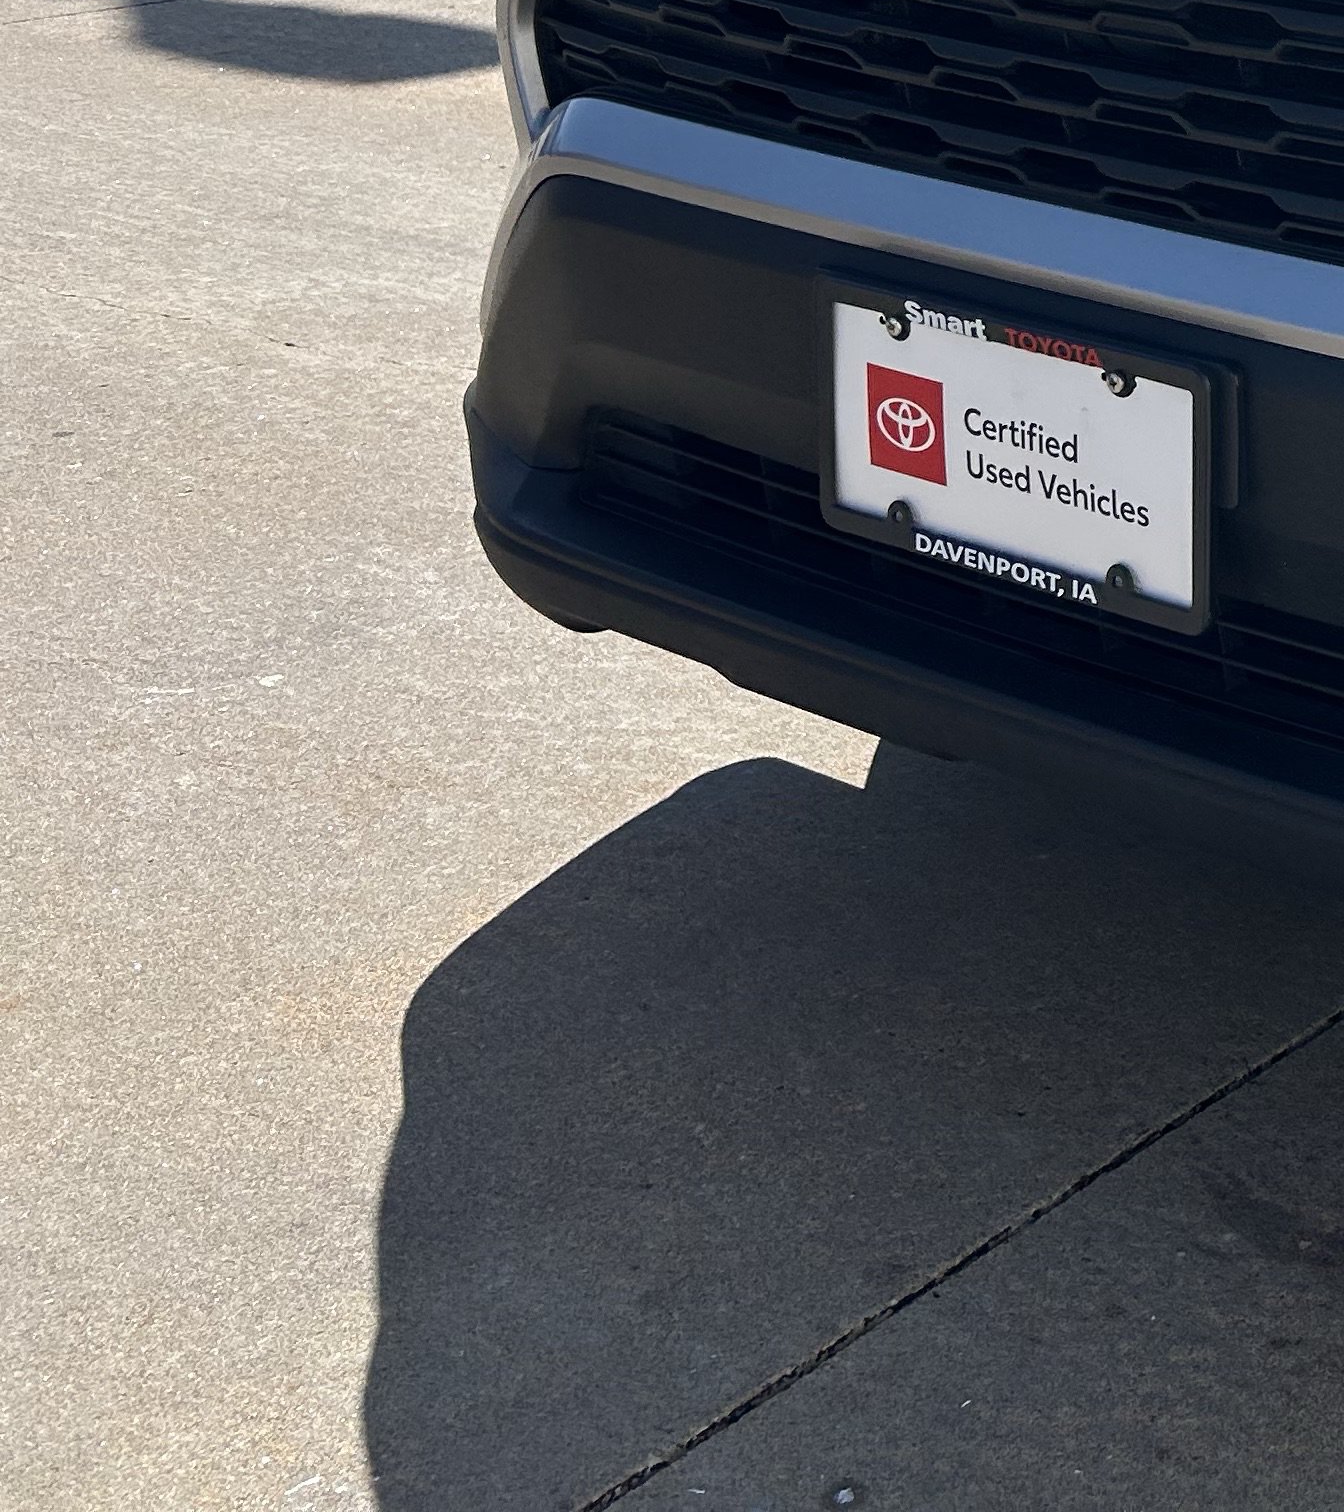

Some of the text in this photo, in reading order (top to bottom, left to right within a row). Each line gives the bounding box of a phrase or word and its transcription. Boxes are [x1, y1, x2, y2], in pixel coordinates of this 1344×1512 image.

[903, 299, 1105, 369] Smart TOYOTA
[963, 407, 1079, 464] Certified
[966, 449, 1151, 528] Used Vehicles
[914, 532, 1099, 605] DAVENPORT, IA
